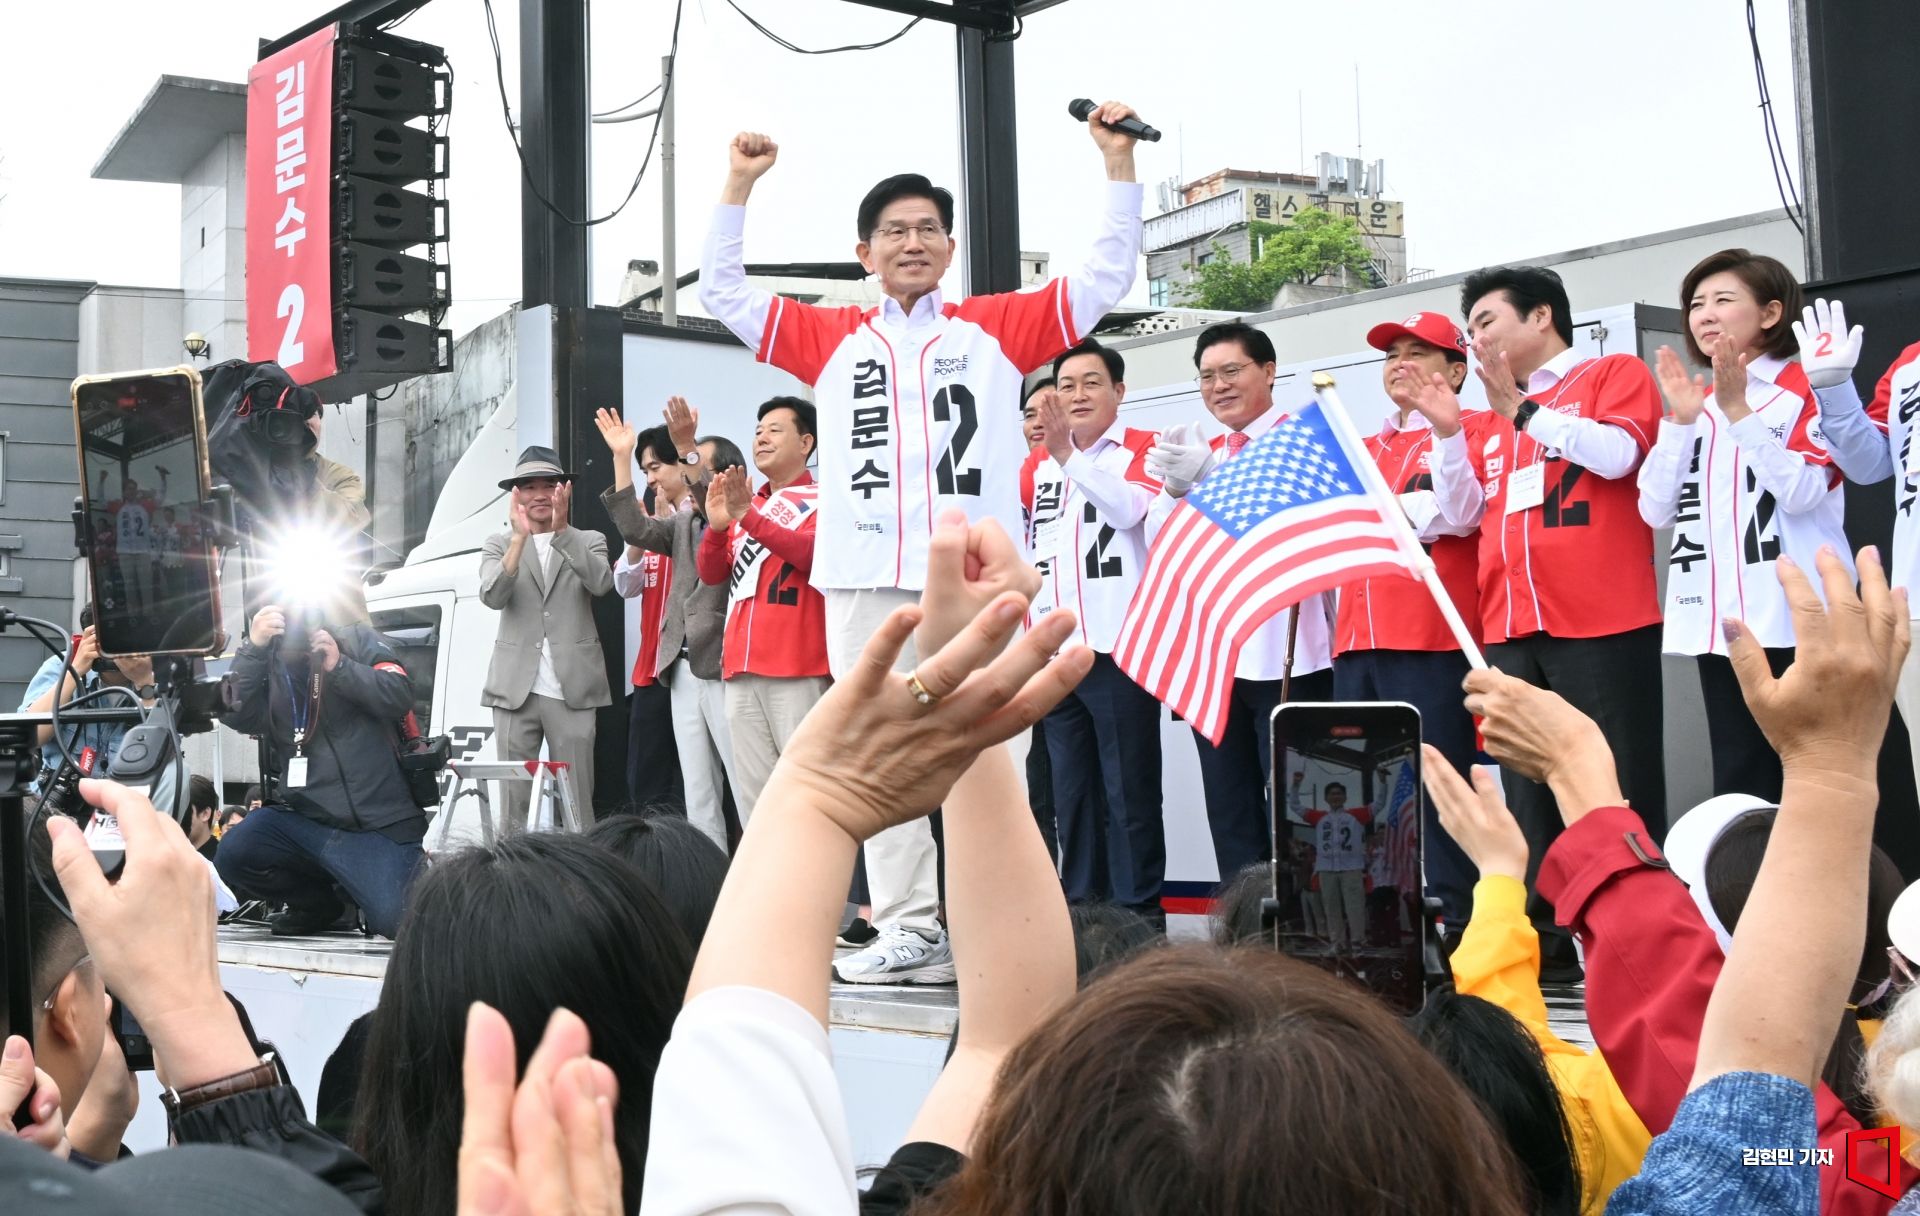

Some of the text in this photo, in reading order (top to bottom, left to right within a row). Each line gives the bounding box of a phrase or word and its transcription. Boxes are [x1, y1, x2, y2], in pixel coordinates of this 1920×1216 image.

[275, 60, 307, 370] 김문수 2
[1403, 313, 1423, 328] 2
[1814, 332, 1833, 357] 2
[934, 354, 968, 368] PEOPLE
[934, 363, 967, 376] POWER
[851, 358, 890, 500] 김문수
[933, 383, 982, 496] 2
[1084, 501, 1123, 579] 2
[1744, 465, 1781, 565] 2
[312, 672, 320, 700] Canon
